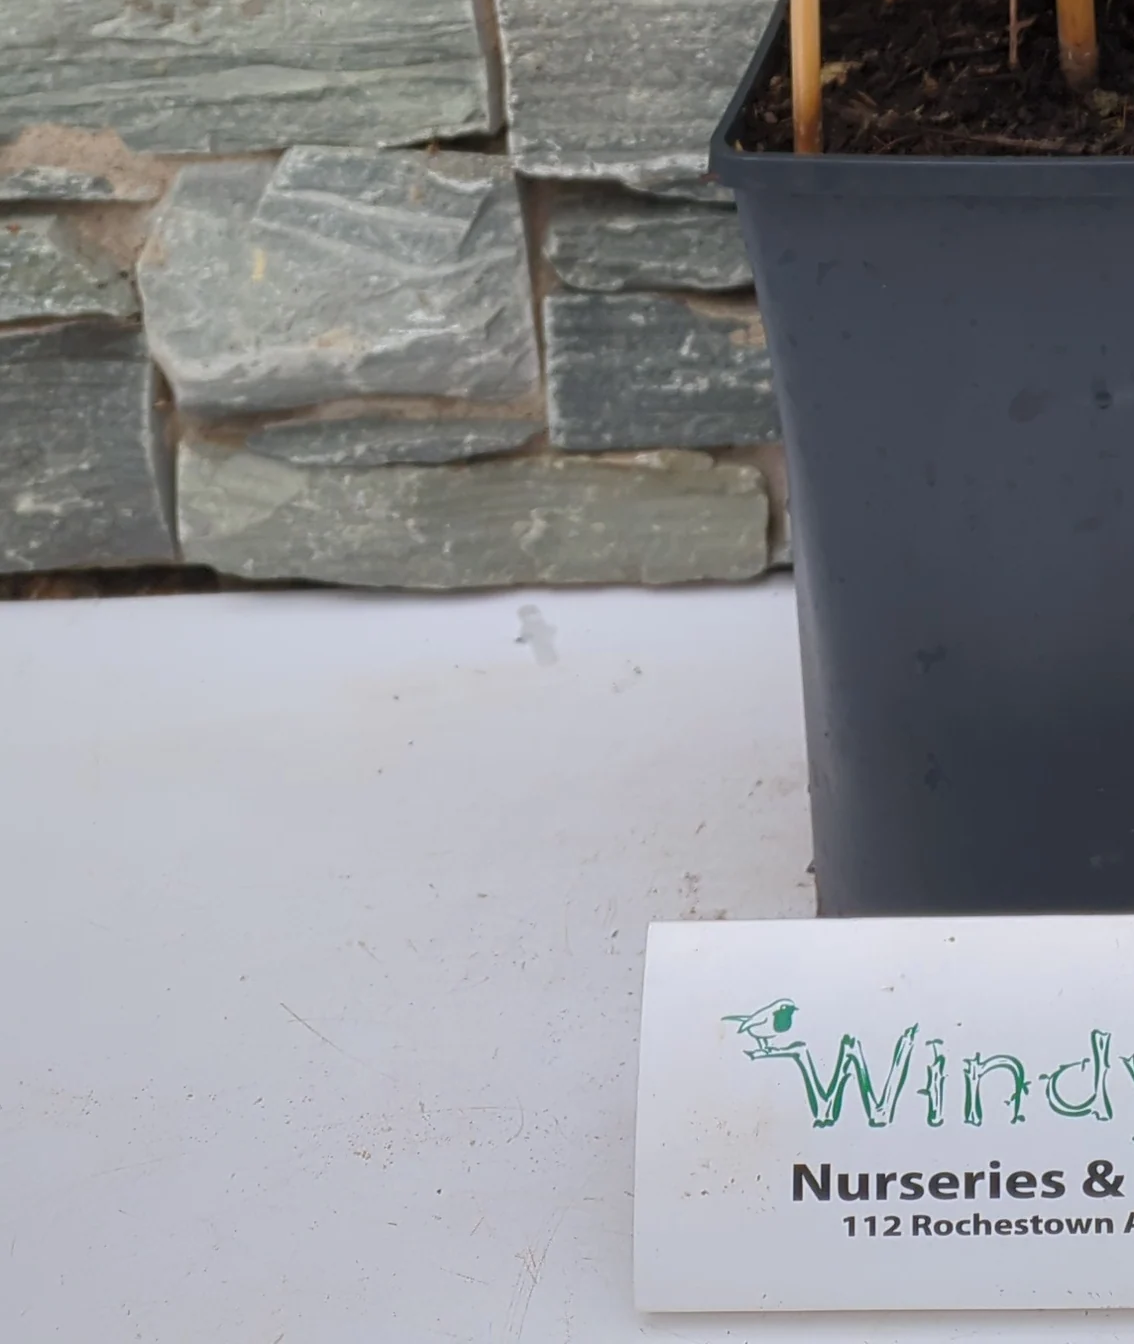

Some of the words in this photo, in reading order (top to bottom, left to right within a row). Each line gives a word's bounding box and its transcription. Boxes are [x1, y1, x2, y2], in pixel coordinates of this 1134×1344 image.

[792, 1161, 1067, 1202] Nurseries
[1082, 1159, 1125, 1199] &
[843, 1215, 902, 1238] 112
[911, 1213, 1115, 1237] Rochestown
